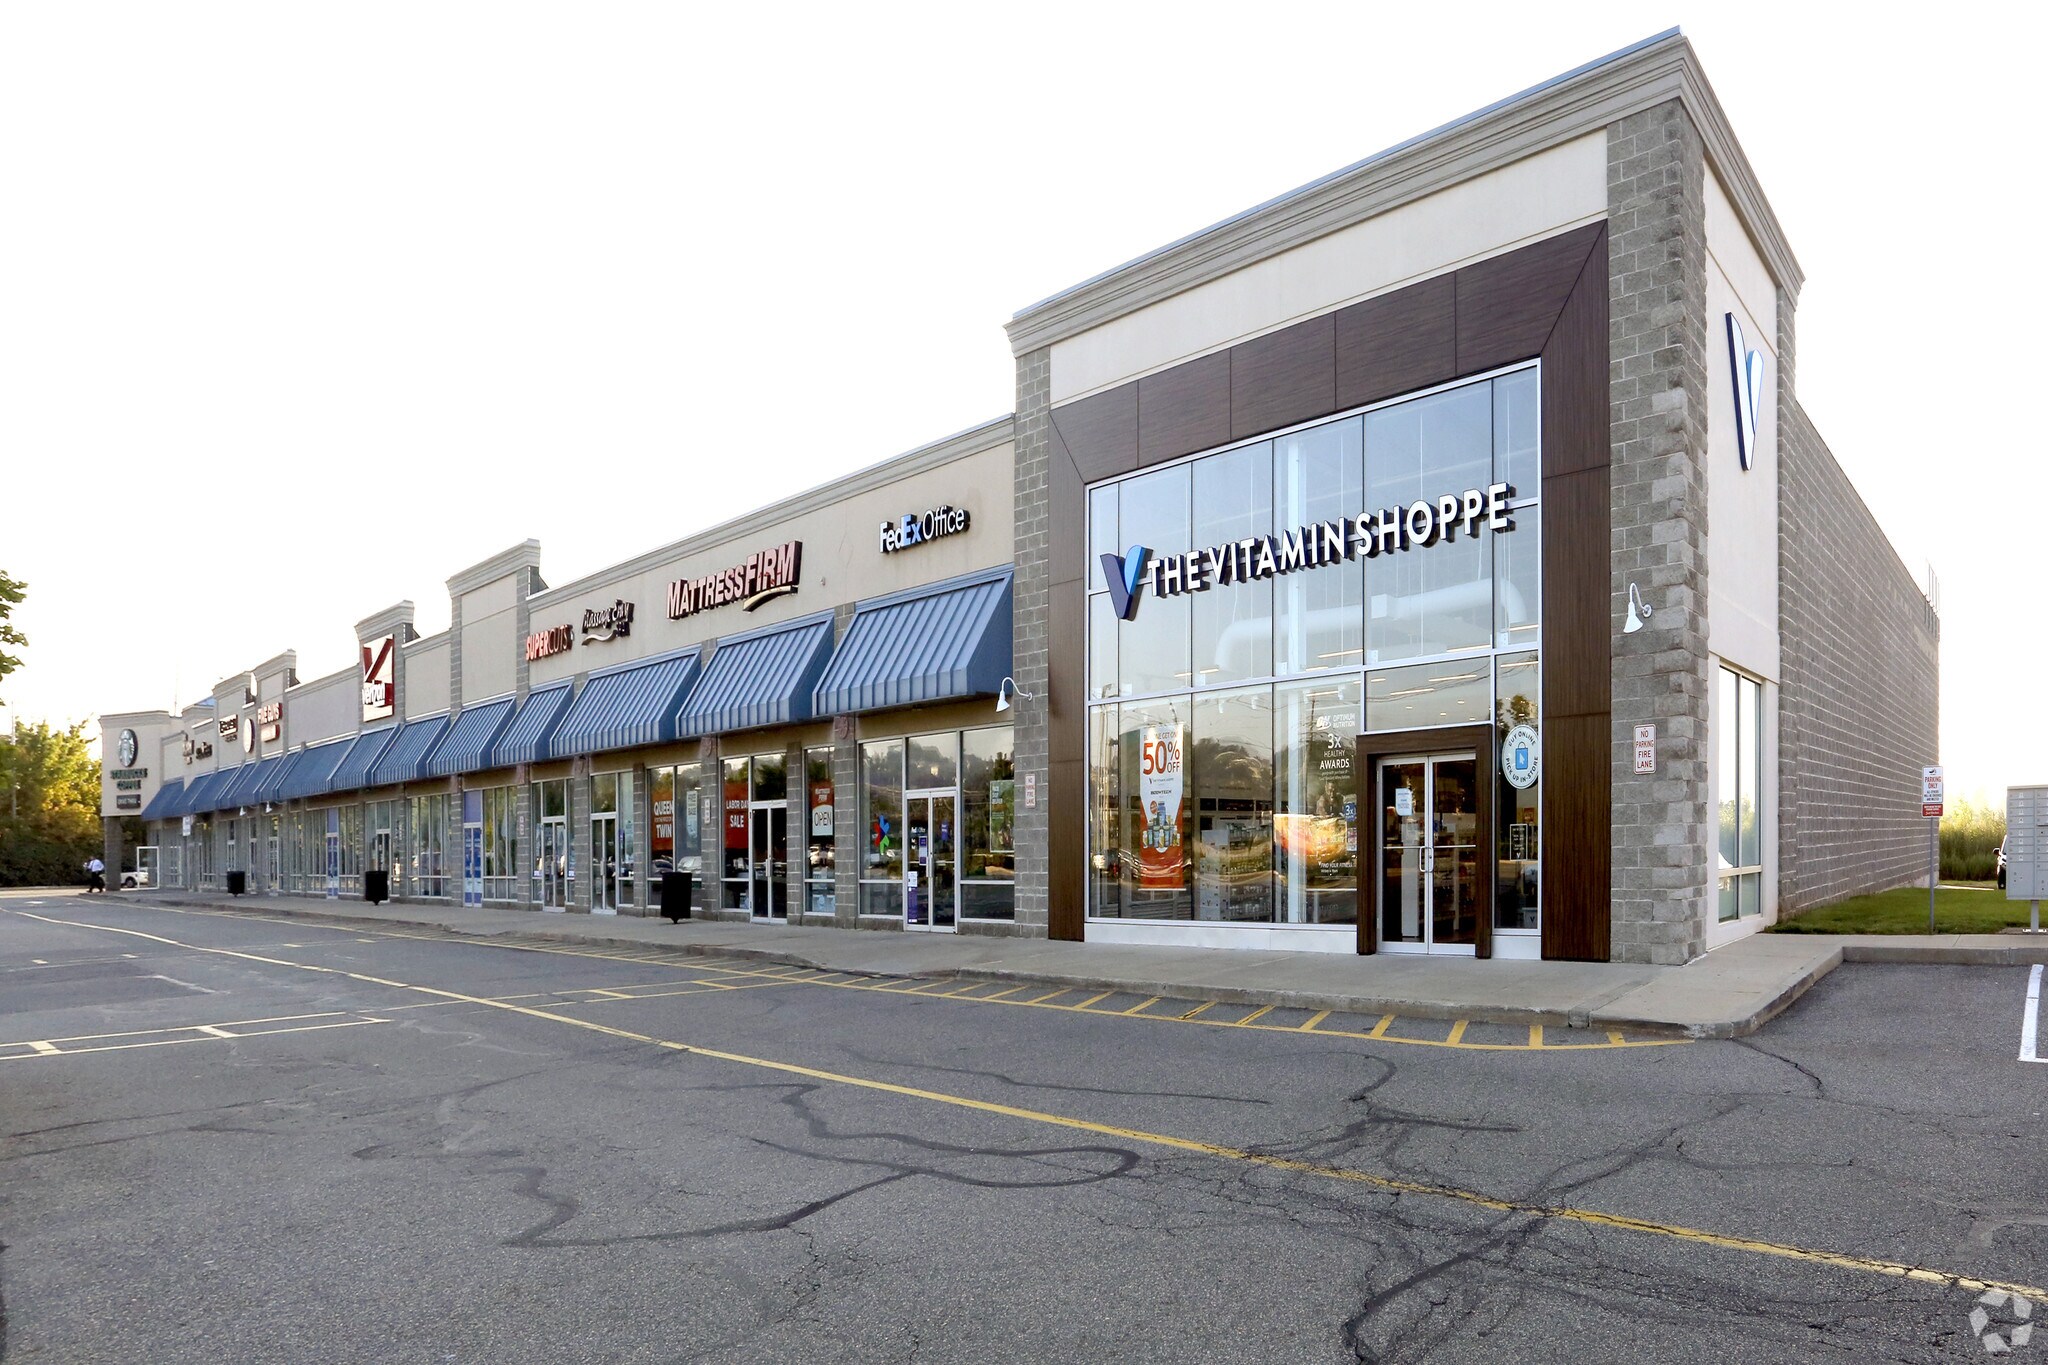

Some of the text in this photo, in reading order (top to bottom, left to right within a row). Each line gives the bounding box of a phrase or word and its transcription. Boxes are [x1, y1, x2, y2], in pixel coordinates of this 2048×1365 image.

[880, 505, 967, 553] FedEx Office
[1147, 550, 1208, 597] THE
[1208, 517, 1351, 584] VITAMIN
[1355, 482, 1513, 558] SHOPPE
[1640, 730, 1649, 738] NO
[1143, 741, 1180, 775] 50%
[1638, 750, 1651, 758] FIRE
[1167, 758, 1180, 773] OFF
[1637, 760, 1652, 768] LANE
[653, 800, 673, 816] QUEEN
[726, 800, 740, 809] LABOR
[730, 815, 744, 828] SALE
[814, 812, 832, 826] OPEN
[656, 824, 672, 838] TWIN
